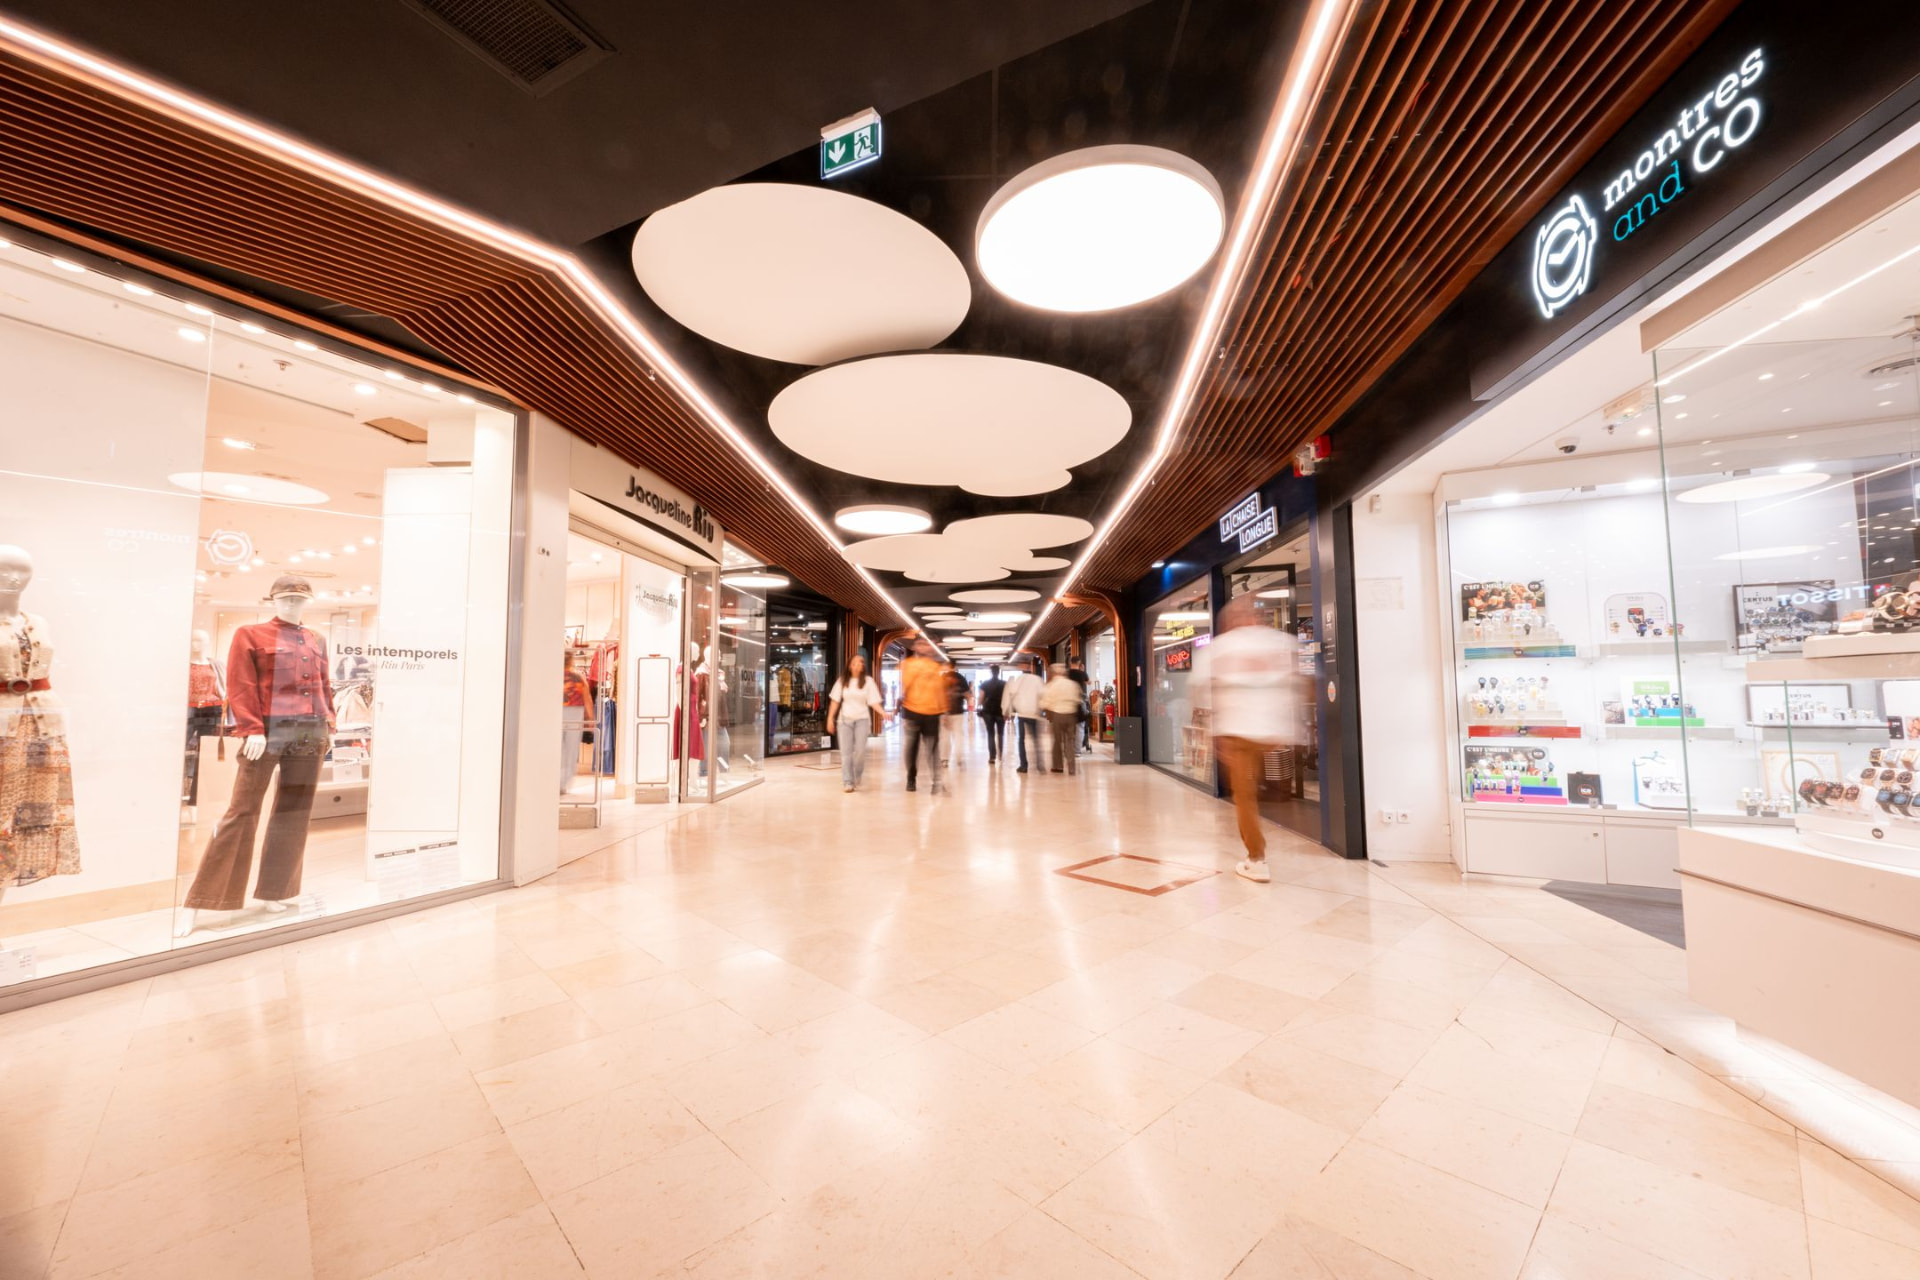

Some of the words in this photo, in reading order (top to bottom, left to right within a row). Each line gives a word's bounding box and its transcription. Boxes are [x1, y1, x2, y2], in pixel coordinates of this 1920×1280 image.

[1603, 48, 1764, 211] montres
[1613, 160, 1684, 241] and
[625, 475, 692, 529] Jacqueline
[692, 502, 714, 543] Riu
[1222, 519, 1230, 535] LA
[1232, 500, 1256, 528] CHAISE
[1241, 515, 1273, 546] LONGUE
[336, 643, 362, 656] Les
[367, 644, 458, 661] intemporels
[381, 660, 398, 669] Riu
[401, 661, 425, 670] Paris
